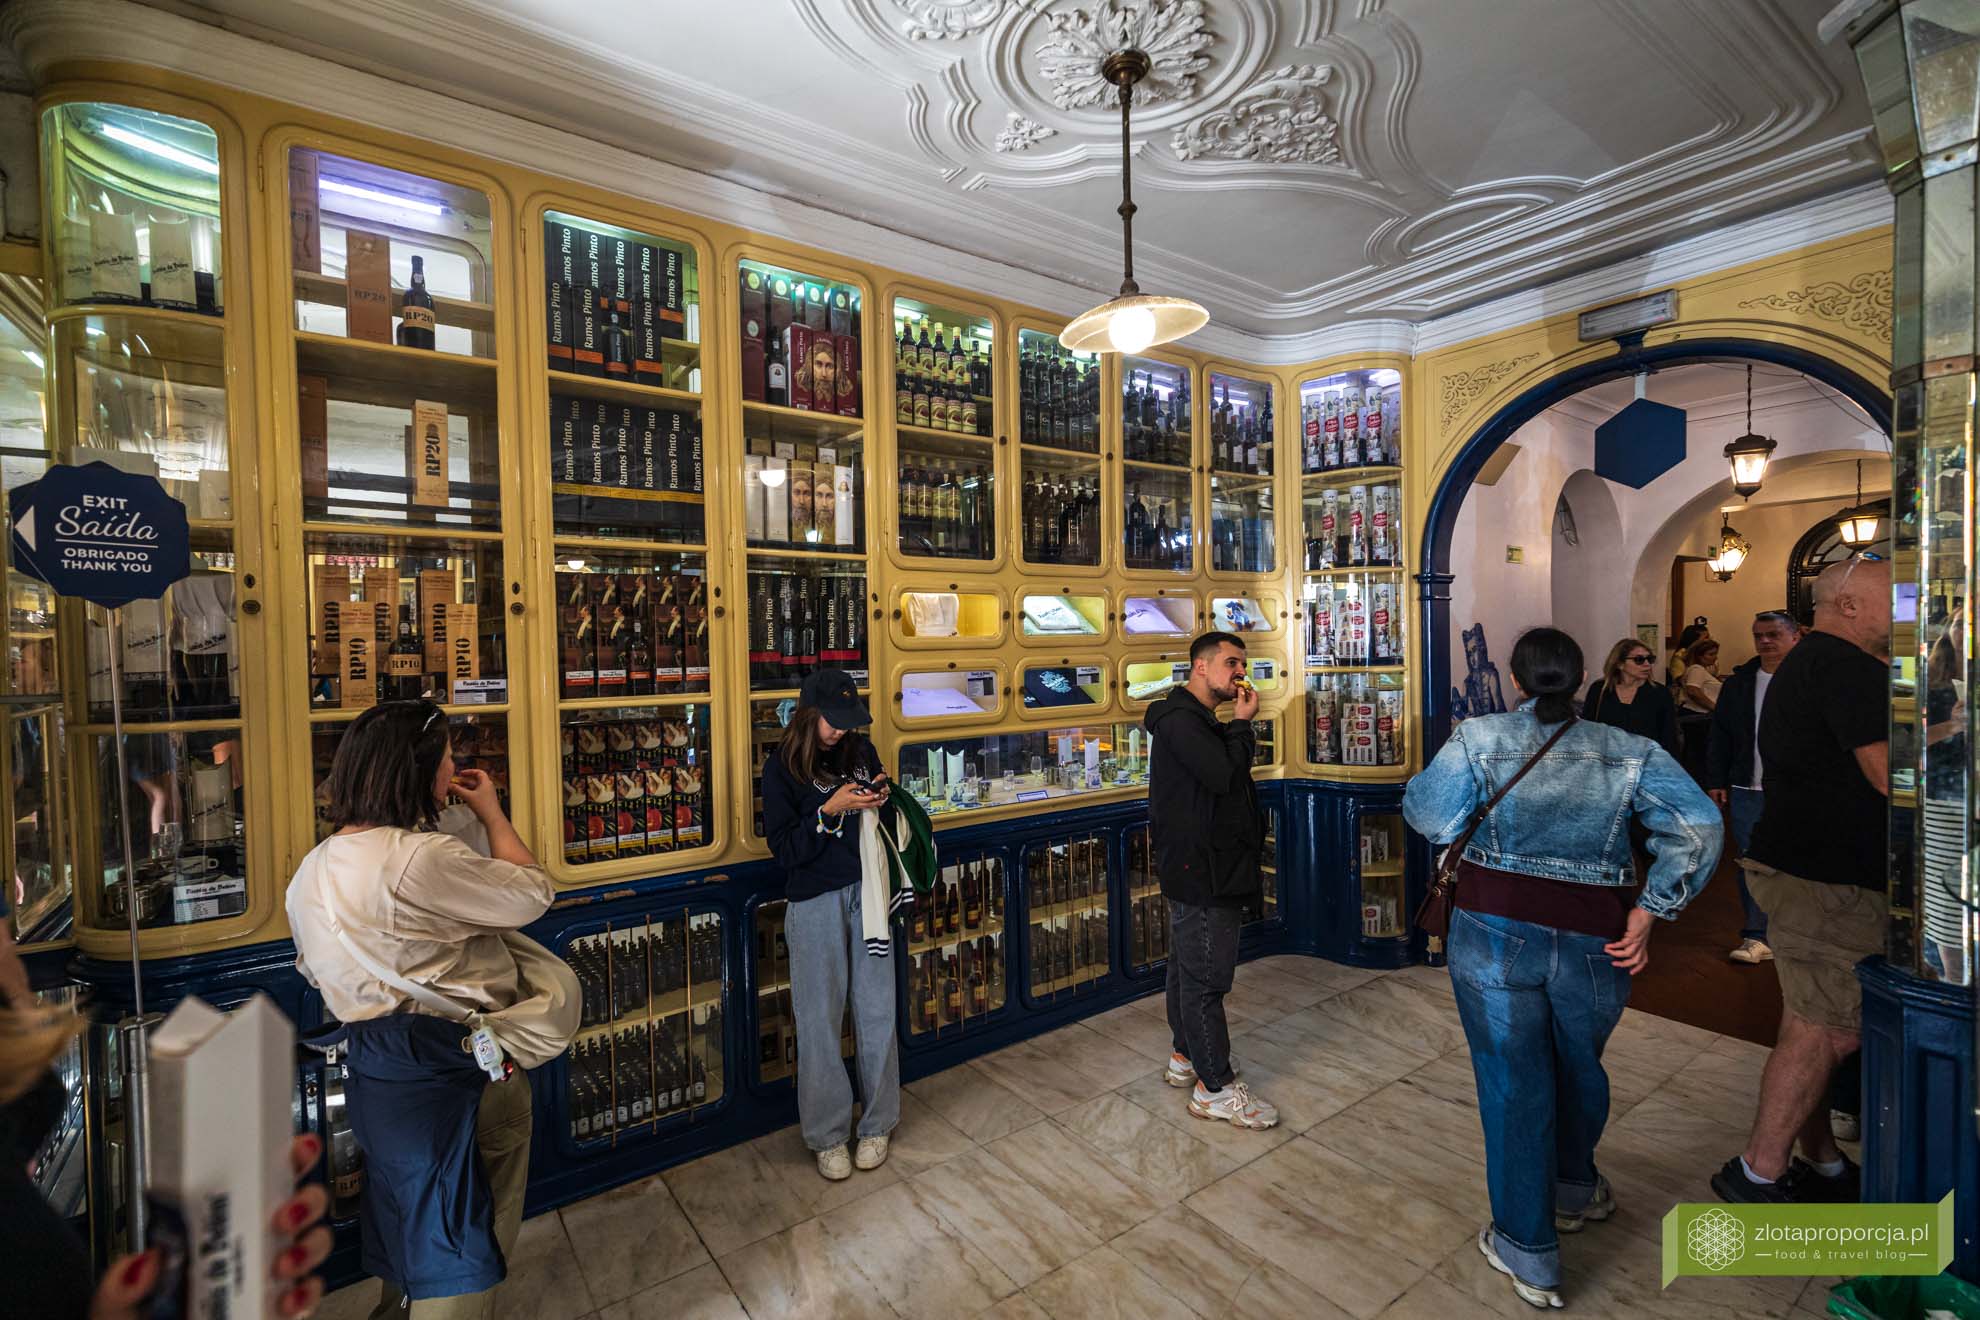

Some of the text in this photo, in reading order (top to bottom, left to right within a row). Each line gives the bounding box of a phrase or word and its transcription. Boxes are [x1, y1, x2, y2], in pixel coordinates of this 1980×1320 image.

[562, 228, 572, 288] amos Pinto
[589, 235, 599, 288] amos Pinto
[616, 241, 625, 298] Ramos Pinto
[642, 247, 650, 298] amos Pinto
[667, 253, 675, 308] Ramos Pinto
[405, 312, 433, 322] RP20
[552, 282, 561, 343] Ramos Pinto
[583, 289, 593, 348] Ramos Pinto
[644, 302, 653, 359] Ramos Pinto
[598, 405, 606, 423] into
[672, 414, 680, 432] into
[425, 434, 440, 477] RP20
[563, 421, 574, 481] Ramos Pinto
[591, 425, 601, 483] Ramos Pinto
[618, 428, 627, 486] Ramos Pinto
[643, 431, 653, 488] Ramos Pinto
[669, 433, 678, 489] Ramos Pinto
[55, 506, 158, 540] Saída
[83, 495, 128, 510] EXIT
[61, 559, 152, 573] THANK YOU
[64, 547, 149, 561] OBRIGADO
[350, 638, 366, 680] RP10
[456, 638, 471, 678] RP10
